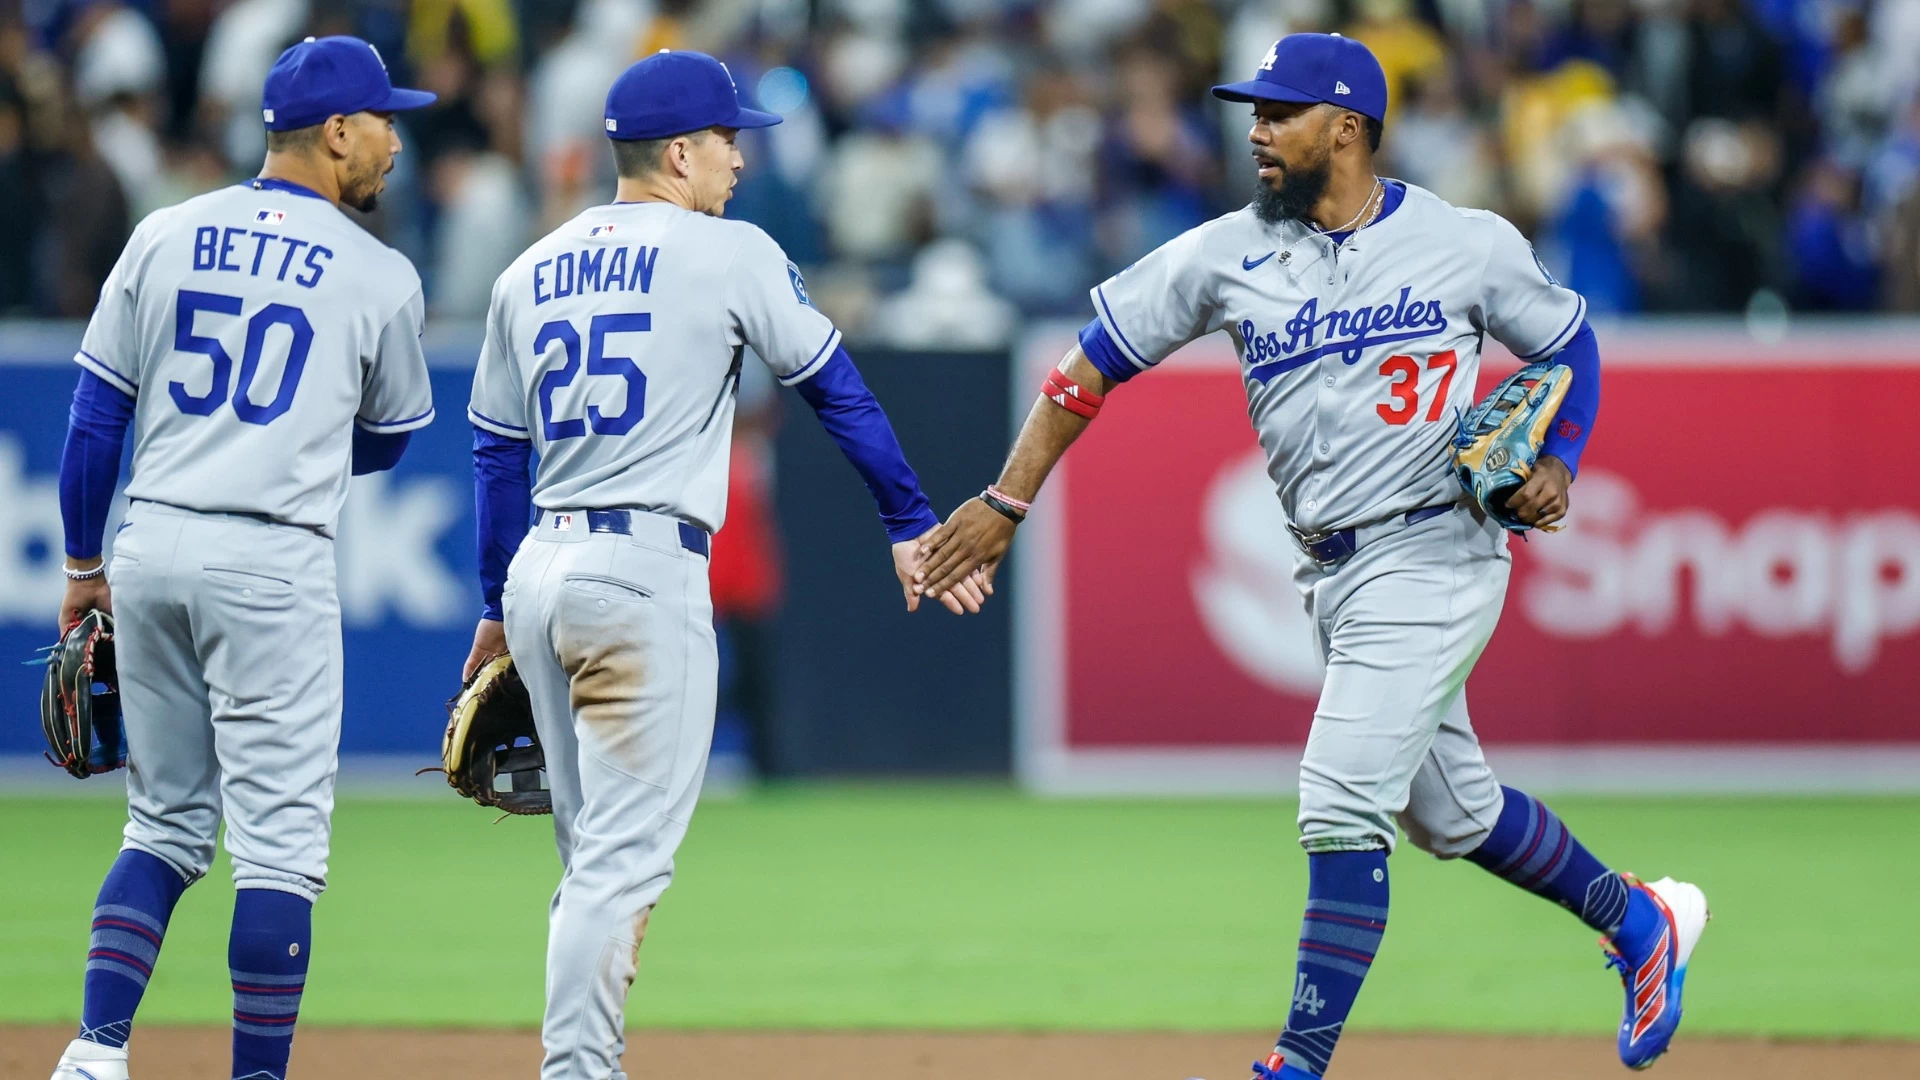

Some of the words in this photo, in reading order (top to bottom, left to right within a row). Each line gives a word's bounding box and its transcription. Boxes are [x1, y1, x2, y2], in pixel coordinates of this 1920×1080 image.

[193, 226, 334, 289] BETTS
[533, 245, 660, 306] EDMAN
[168, 289, 315, 426] 50
[1237, 319, 1283, 364] Los
[1281, 286, 1448, 366] Angeles
[533, 312, 652, 441] 25
[1376, 349, 1458, 426] 37
[1558, 419, 1582, 442] 37
[1293, 972, 1326, 1017] LA
